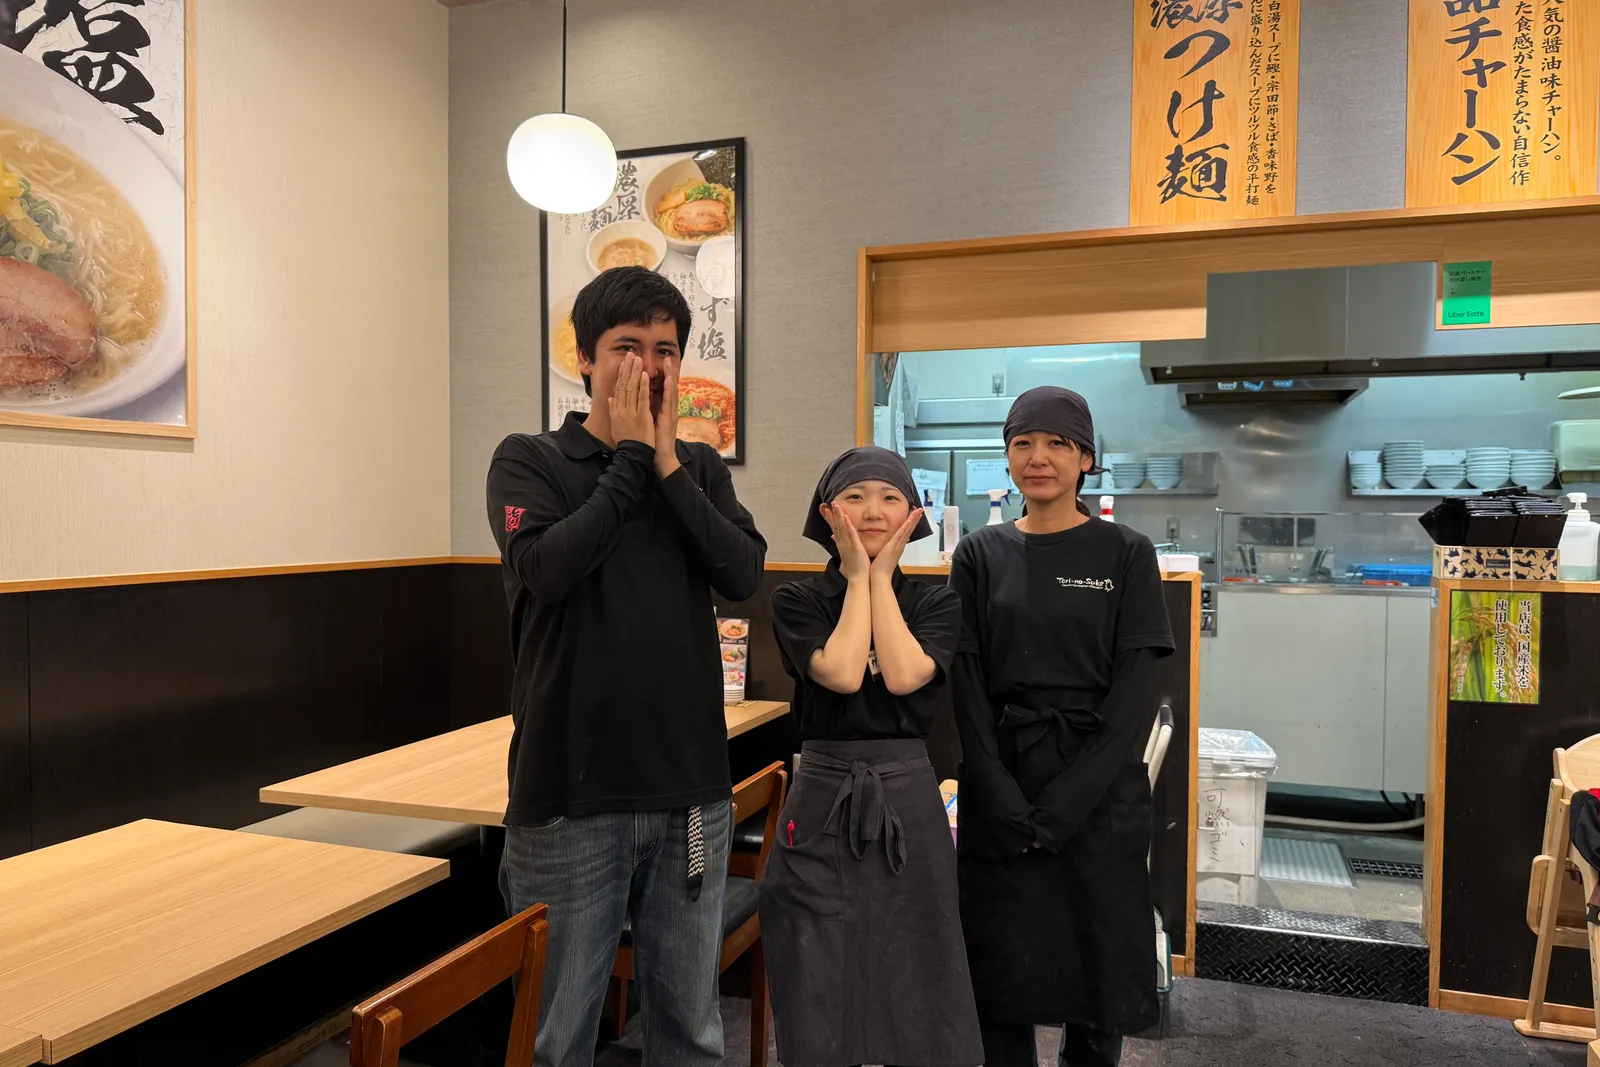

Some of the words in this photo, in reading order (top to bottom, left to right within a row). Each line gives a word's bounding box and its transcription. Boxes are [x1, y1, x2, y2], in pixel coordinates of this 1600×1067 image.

[1509, 1, 1535, 186] た食感がたまらない自信作
[1493, 600, 1508, 697] 使用しております。
[1517, 600, 1532, 688] 当店は、国産米を
